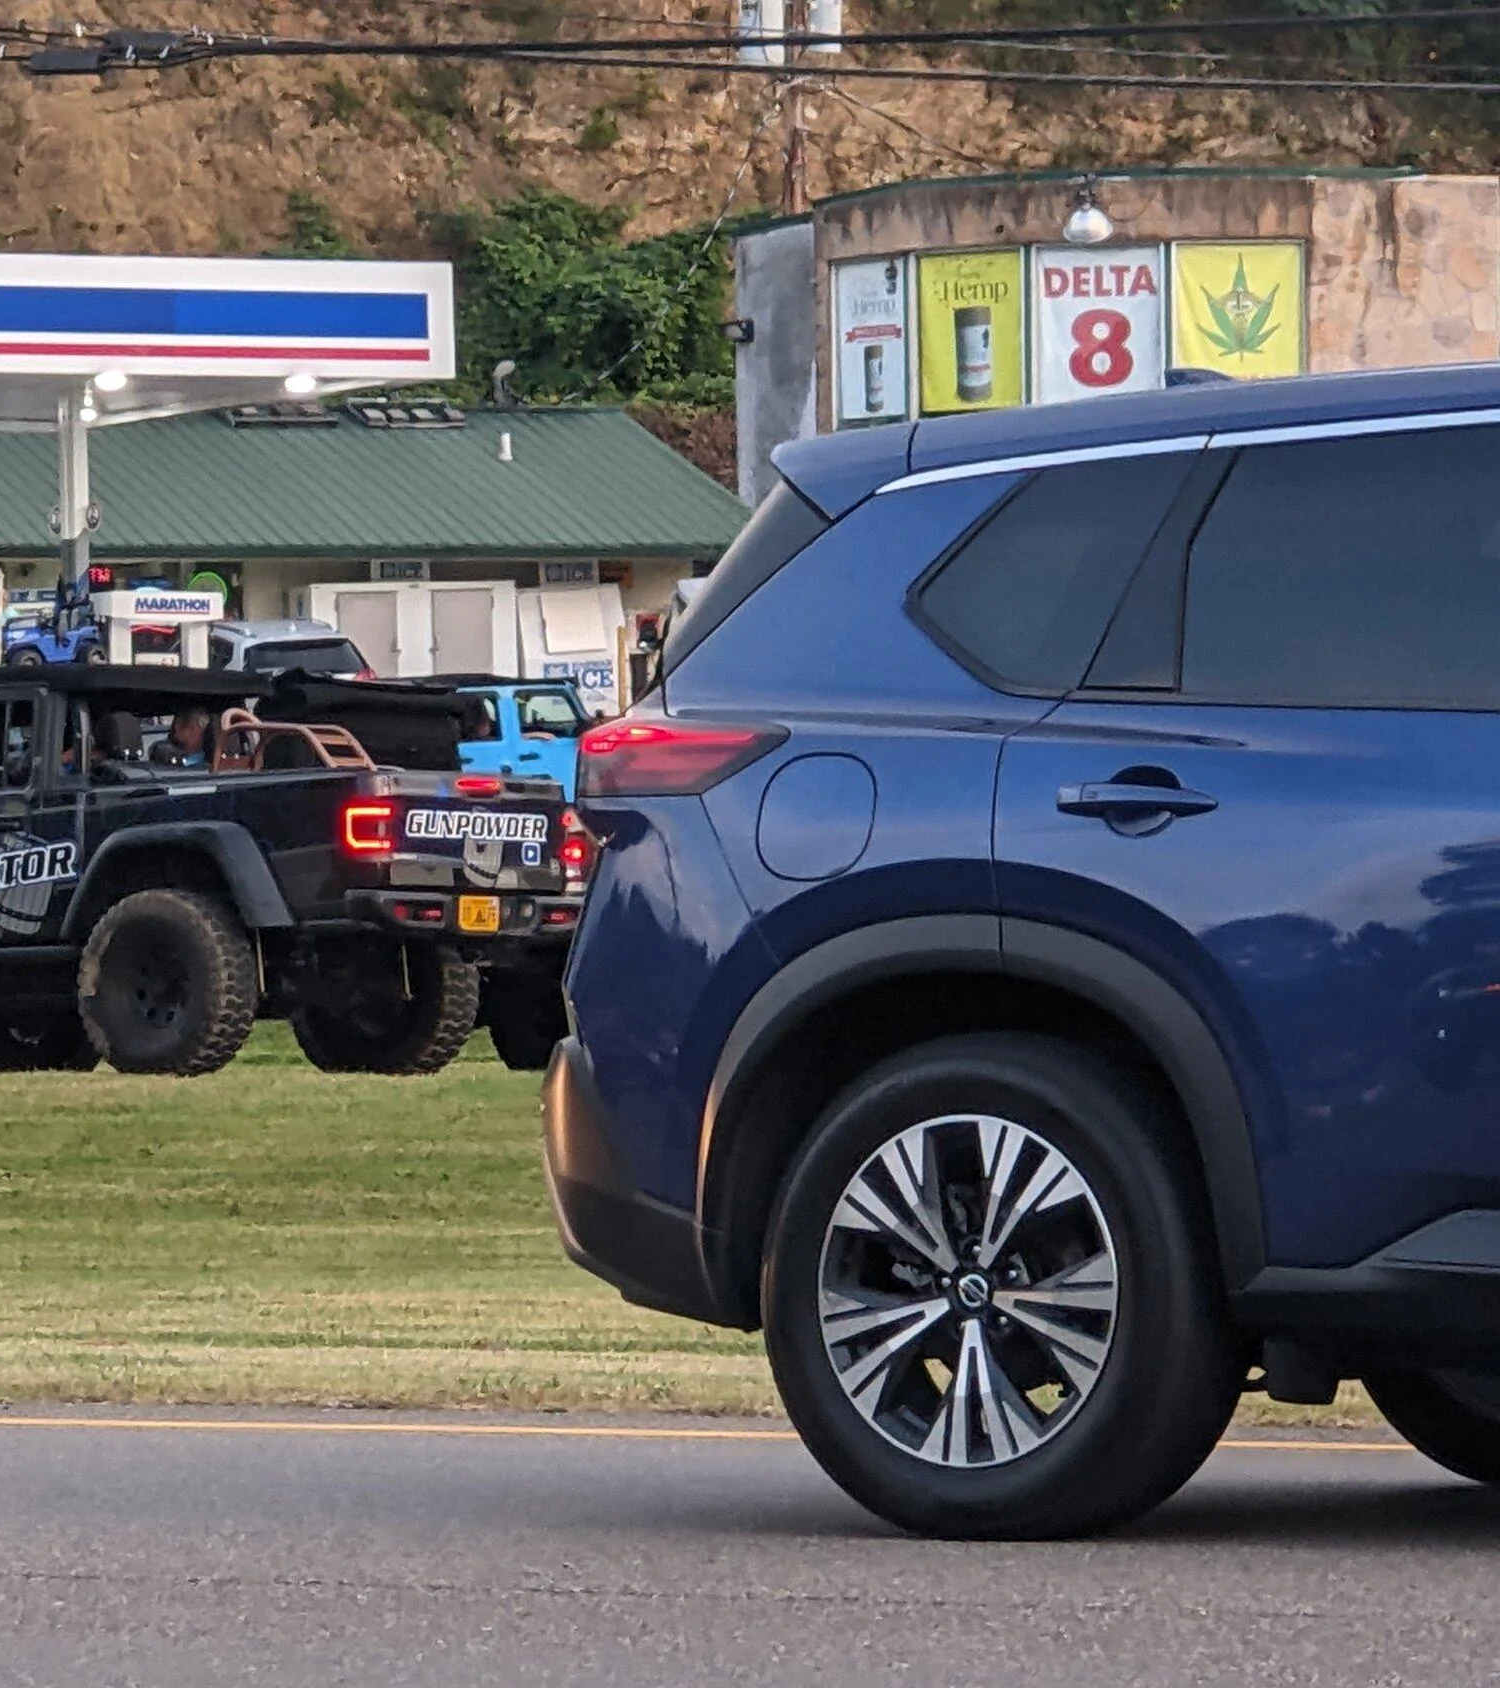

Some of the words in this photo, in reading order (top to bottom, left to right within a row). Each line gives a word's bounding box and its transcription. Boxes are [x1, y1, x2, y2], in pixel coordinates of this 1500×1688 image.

[940, 278, 1008, 304] Hemp
[1043, 264, 1157, 298] DELTA
[1069, 308, 1133, 387] 8
[135, 597, 210, 610] MARATHON
[405, 809, 549, 842] GUNPOWDER
